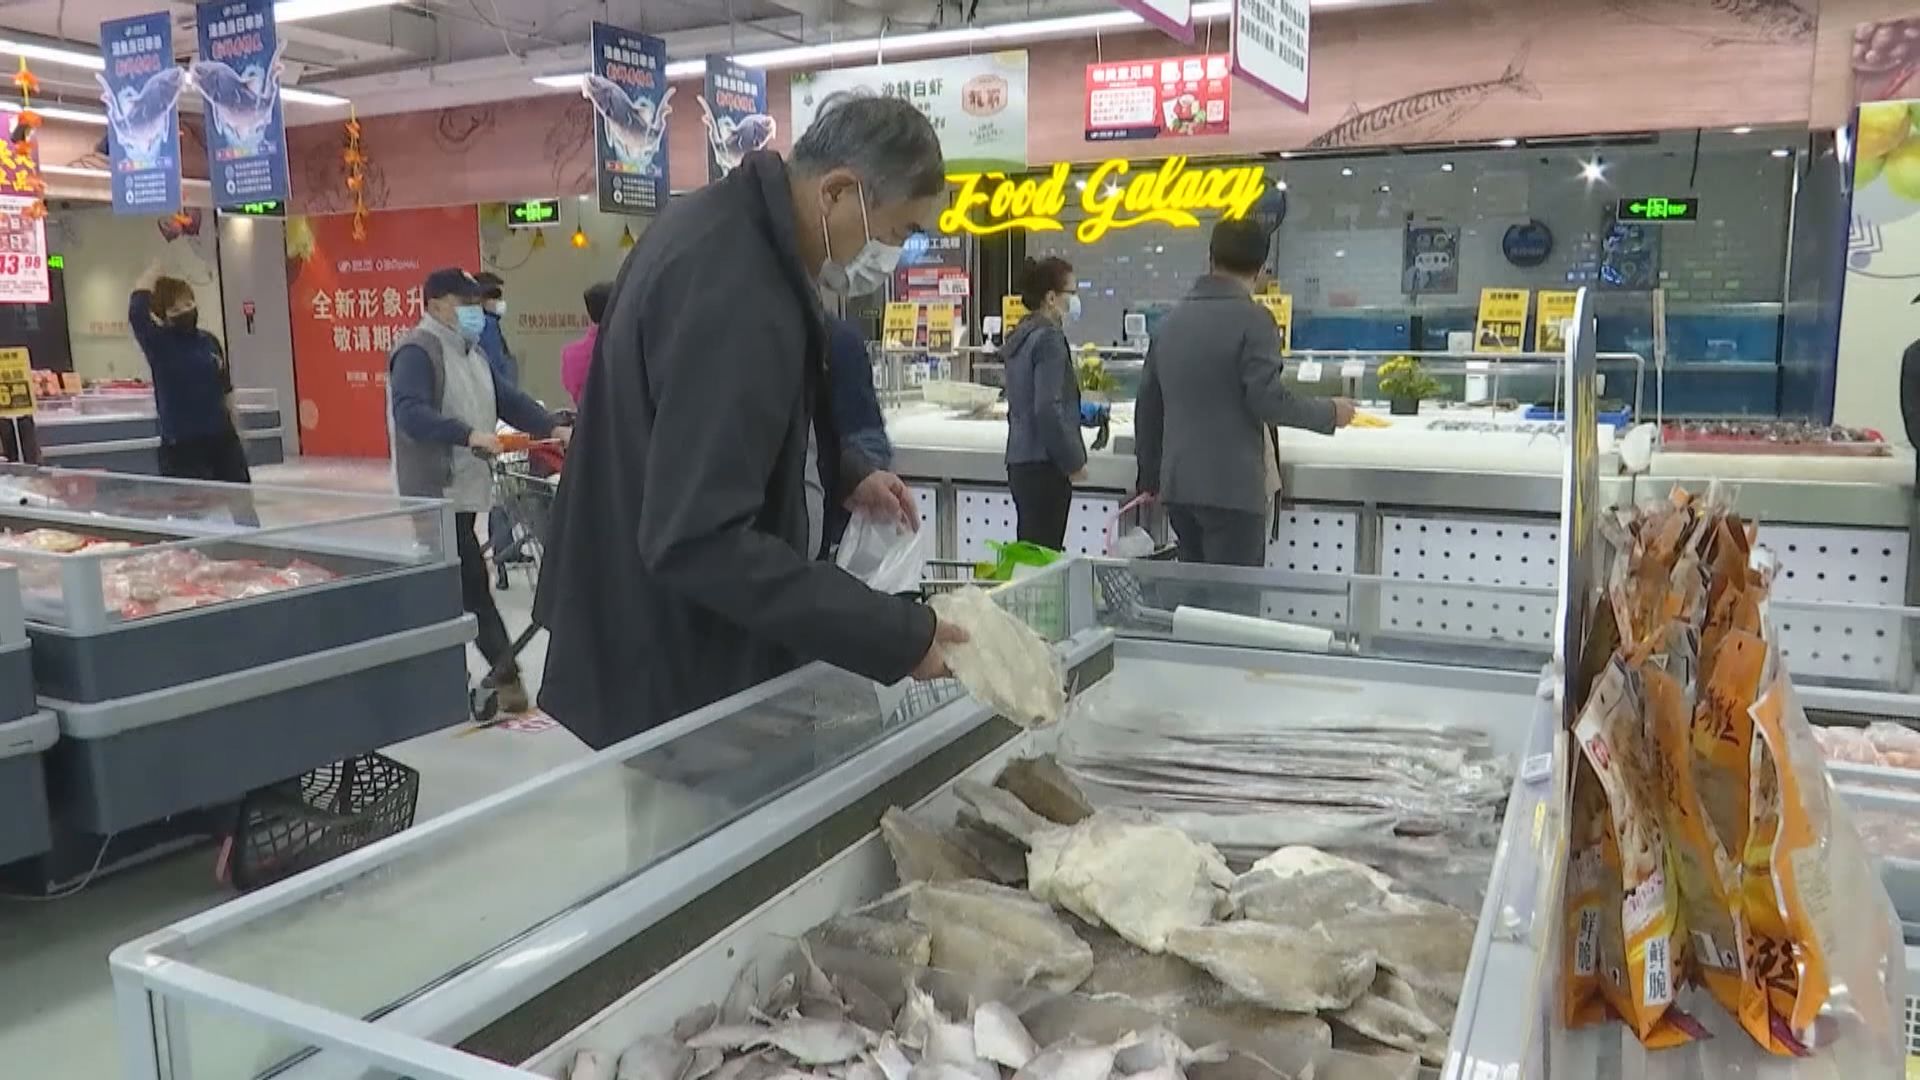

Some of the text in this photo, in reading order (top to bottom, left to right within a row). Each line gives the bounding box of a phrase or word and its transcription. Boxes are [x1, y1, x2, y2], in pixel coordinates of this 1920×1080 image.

[939, 155, 1265, 244] Food Galaxy
[1648, 937, 1668, 1000] 鲜脆
